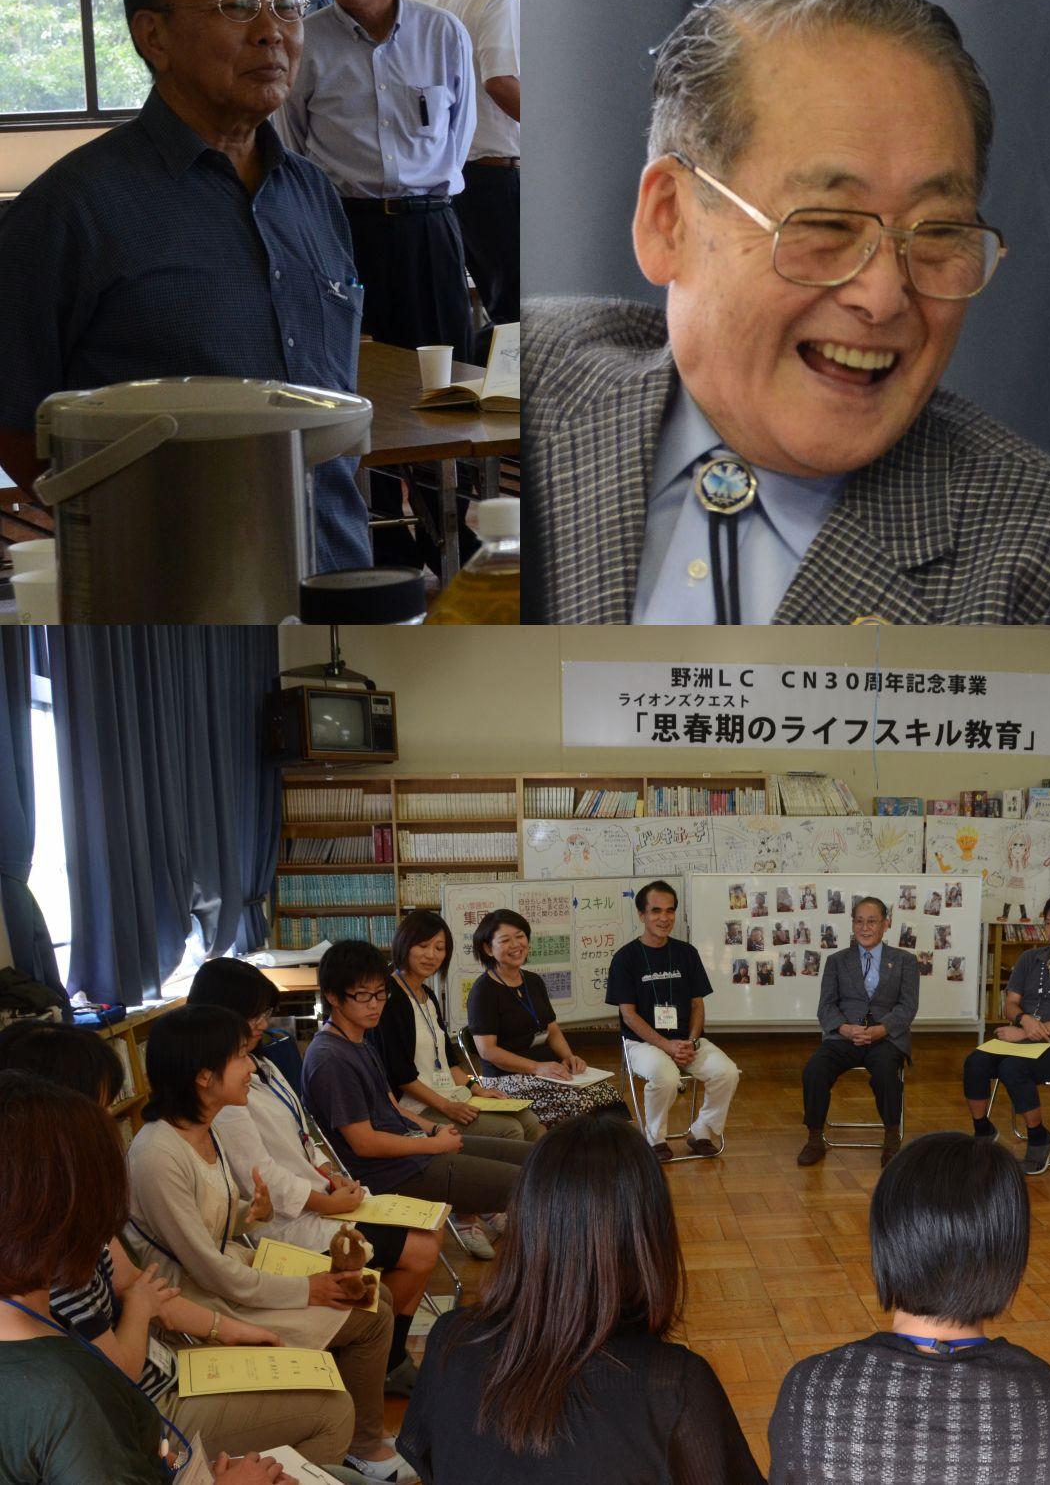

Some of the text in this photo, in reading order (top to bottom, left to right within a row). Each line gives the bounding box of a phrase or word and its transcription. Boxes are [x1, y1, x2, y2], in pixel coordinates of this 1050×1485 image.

[670, 666, 988, 697] 野洲LC CN30周年記念事業
[618, 692, 751, 709] ライオンズクエスト
[632, 711, 1037, 751] 「思春期のライフスキル教育」
[580, 896, 615, 911] スキル
[580, 934, 615, 949] やり方
